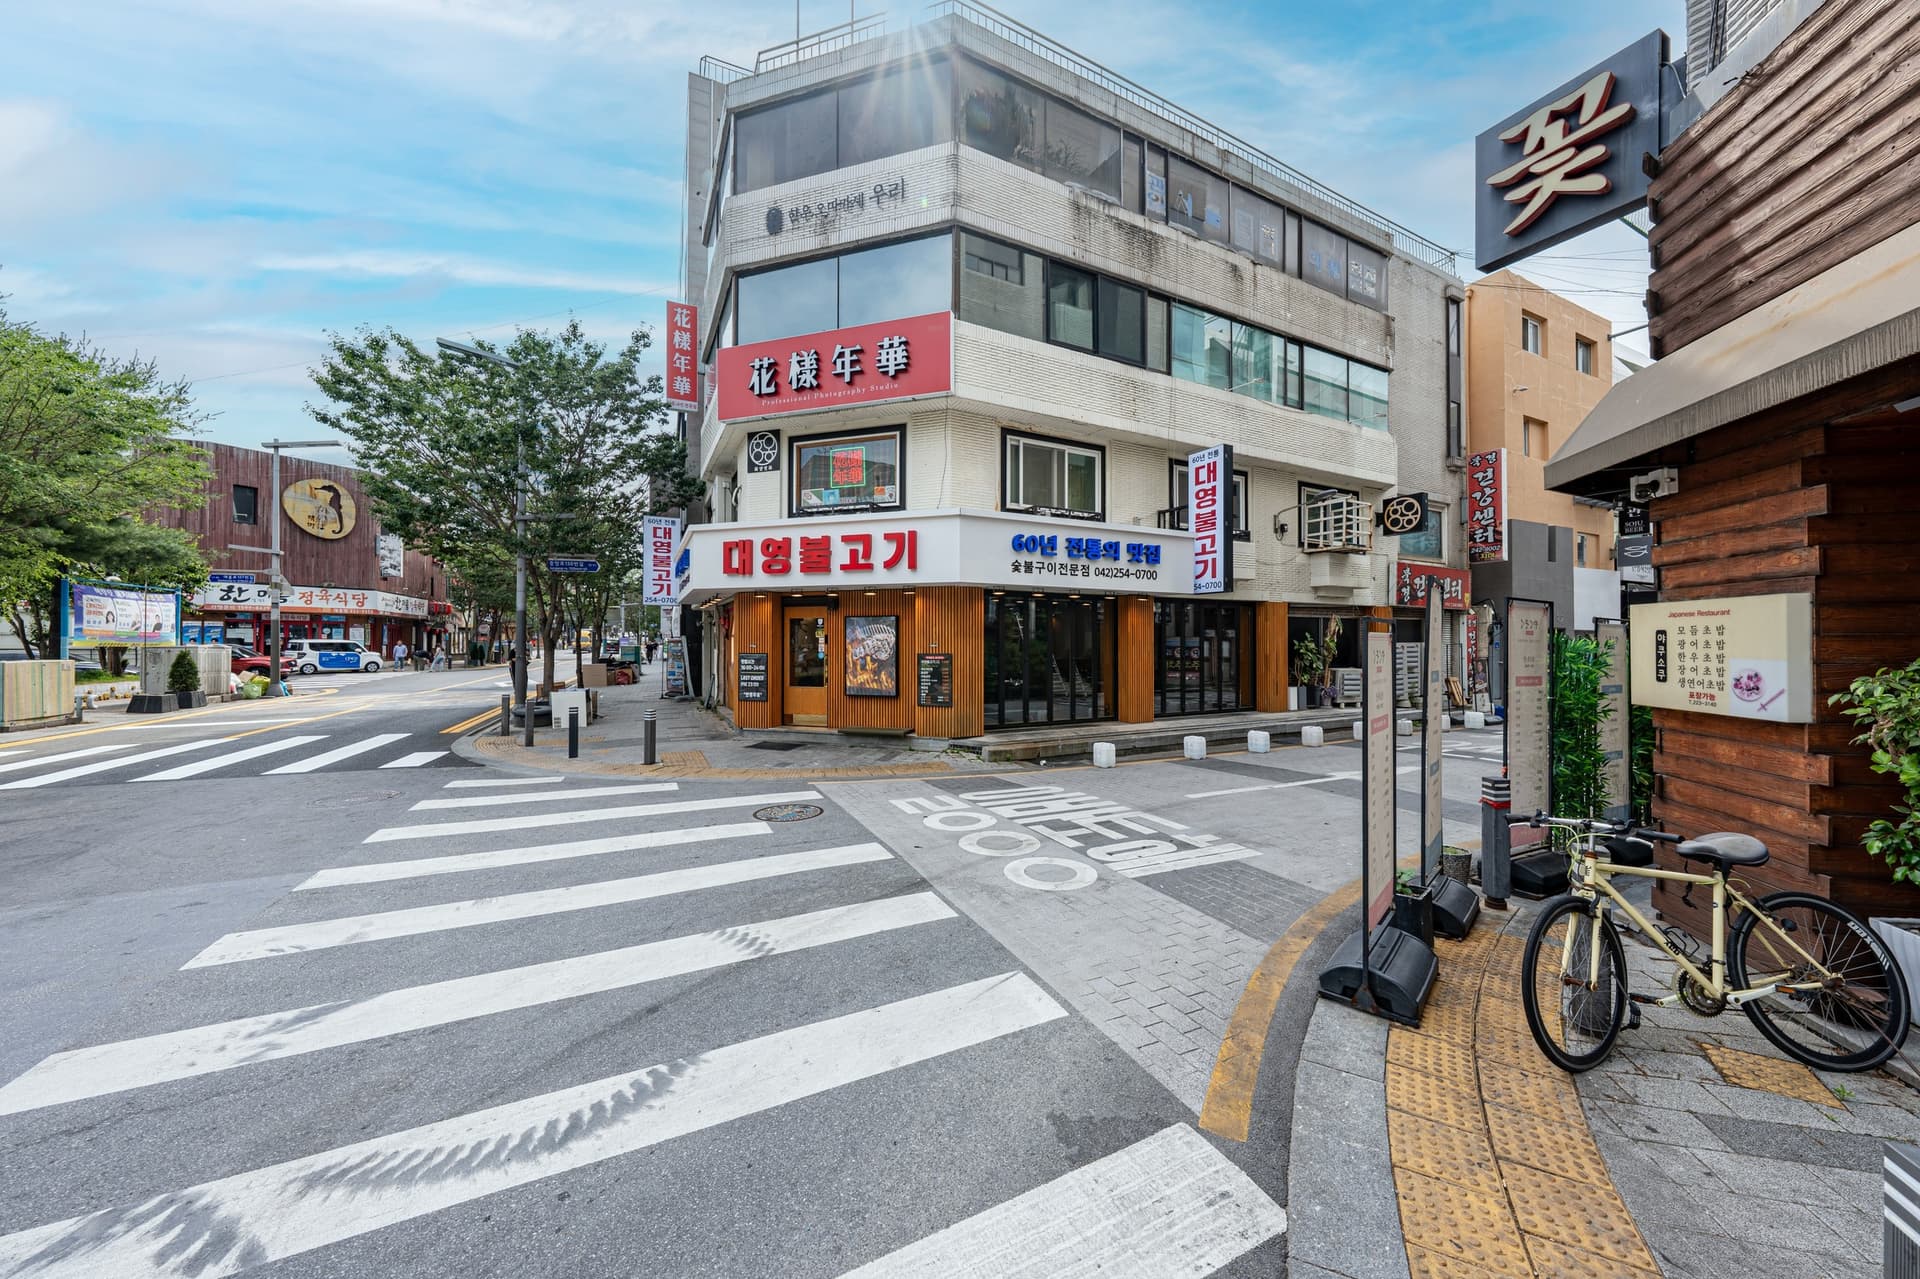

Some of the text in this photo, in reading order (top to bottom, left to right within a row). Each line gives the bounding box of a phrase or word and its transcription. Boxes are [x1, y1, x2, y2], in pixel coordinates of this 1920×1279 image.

[869, 177, 909, 205] 우리
[672, 307, 692, 396] 花樣年華
[749, 335, 910, 396] 花樣年華
[761, 382, 899, 406] Professional Photography Studio
[1192, 448, 1220, 464] 60년 전통
[1471, 466, 1497, 544] 건강센터
[647, 518, 662, 526] 60년
[1194, 461, 1217, 580] 대영불고기
[652, 526, 673, 597] 대영불고기
[722, 529, 918, 577] 대영불고기
[1011, 533, 1162, 565] 60년 전통의 맛집
[1011, 559, 1158, 581] 숯불구이전문점 042)254-0700
[298, 588, 368, 608] 정육식당
[1667, 608, 1731, 619] Japanese Restaurant
[1678, 677, 1726, 692] 생연어초밥
[1688, 691, 1717, 702] 포장가능
